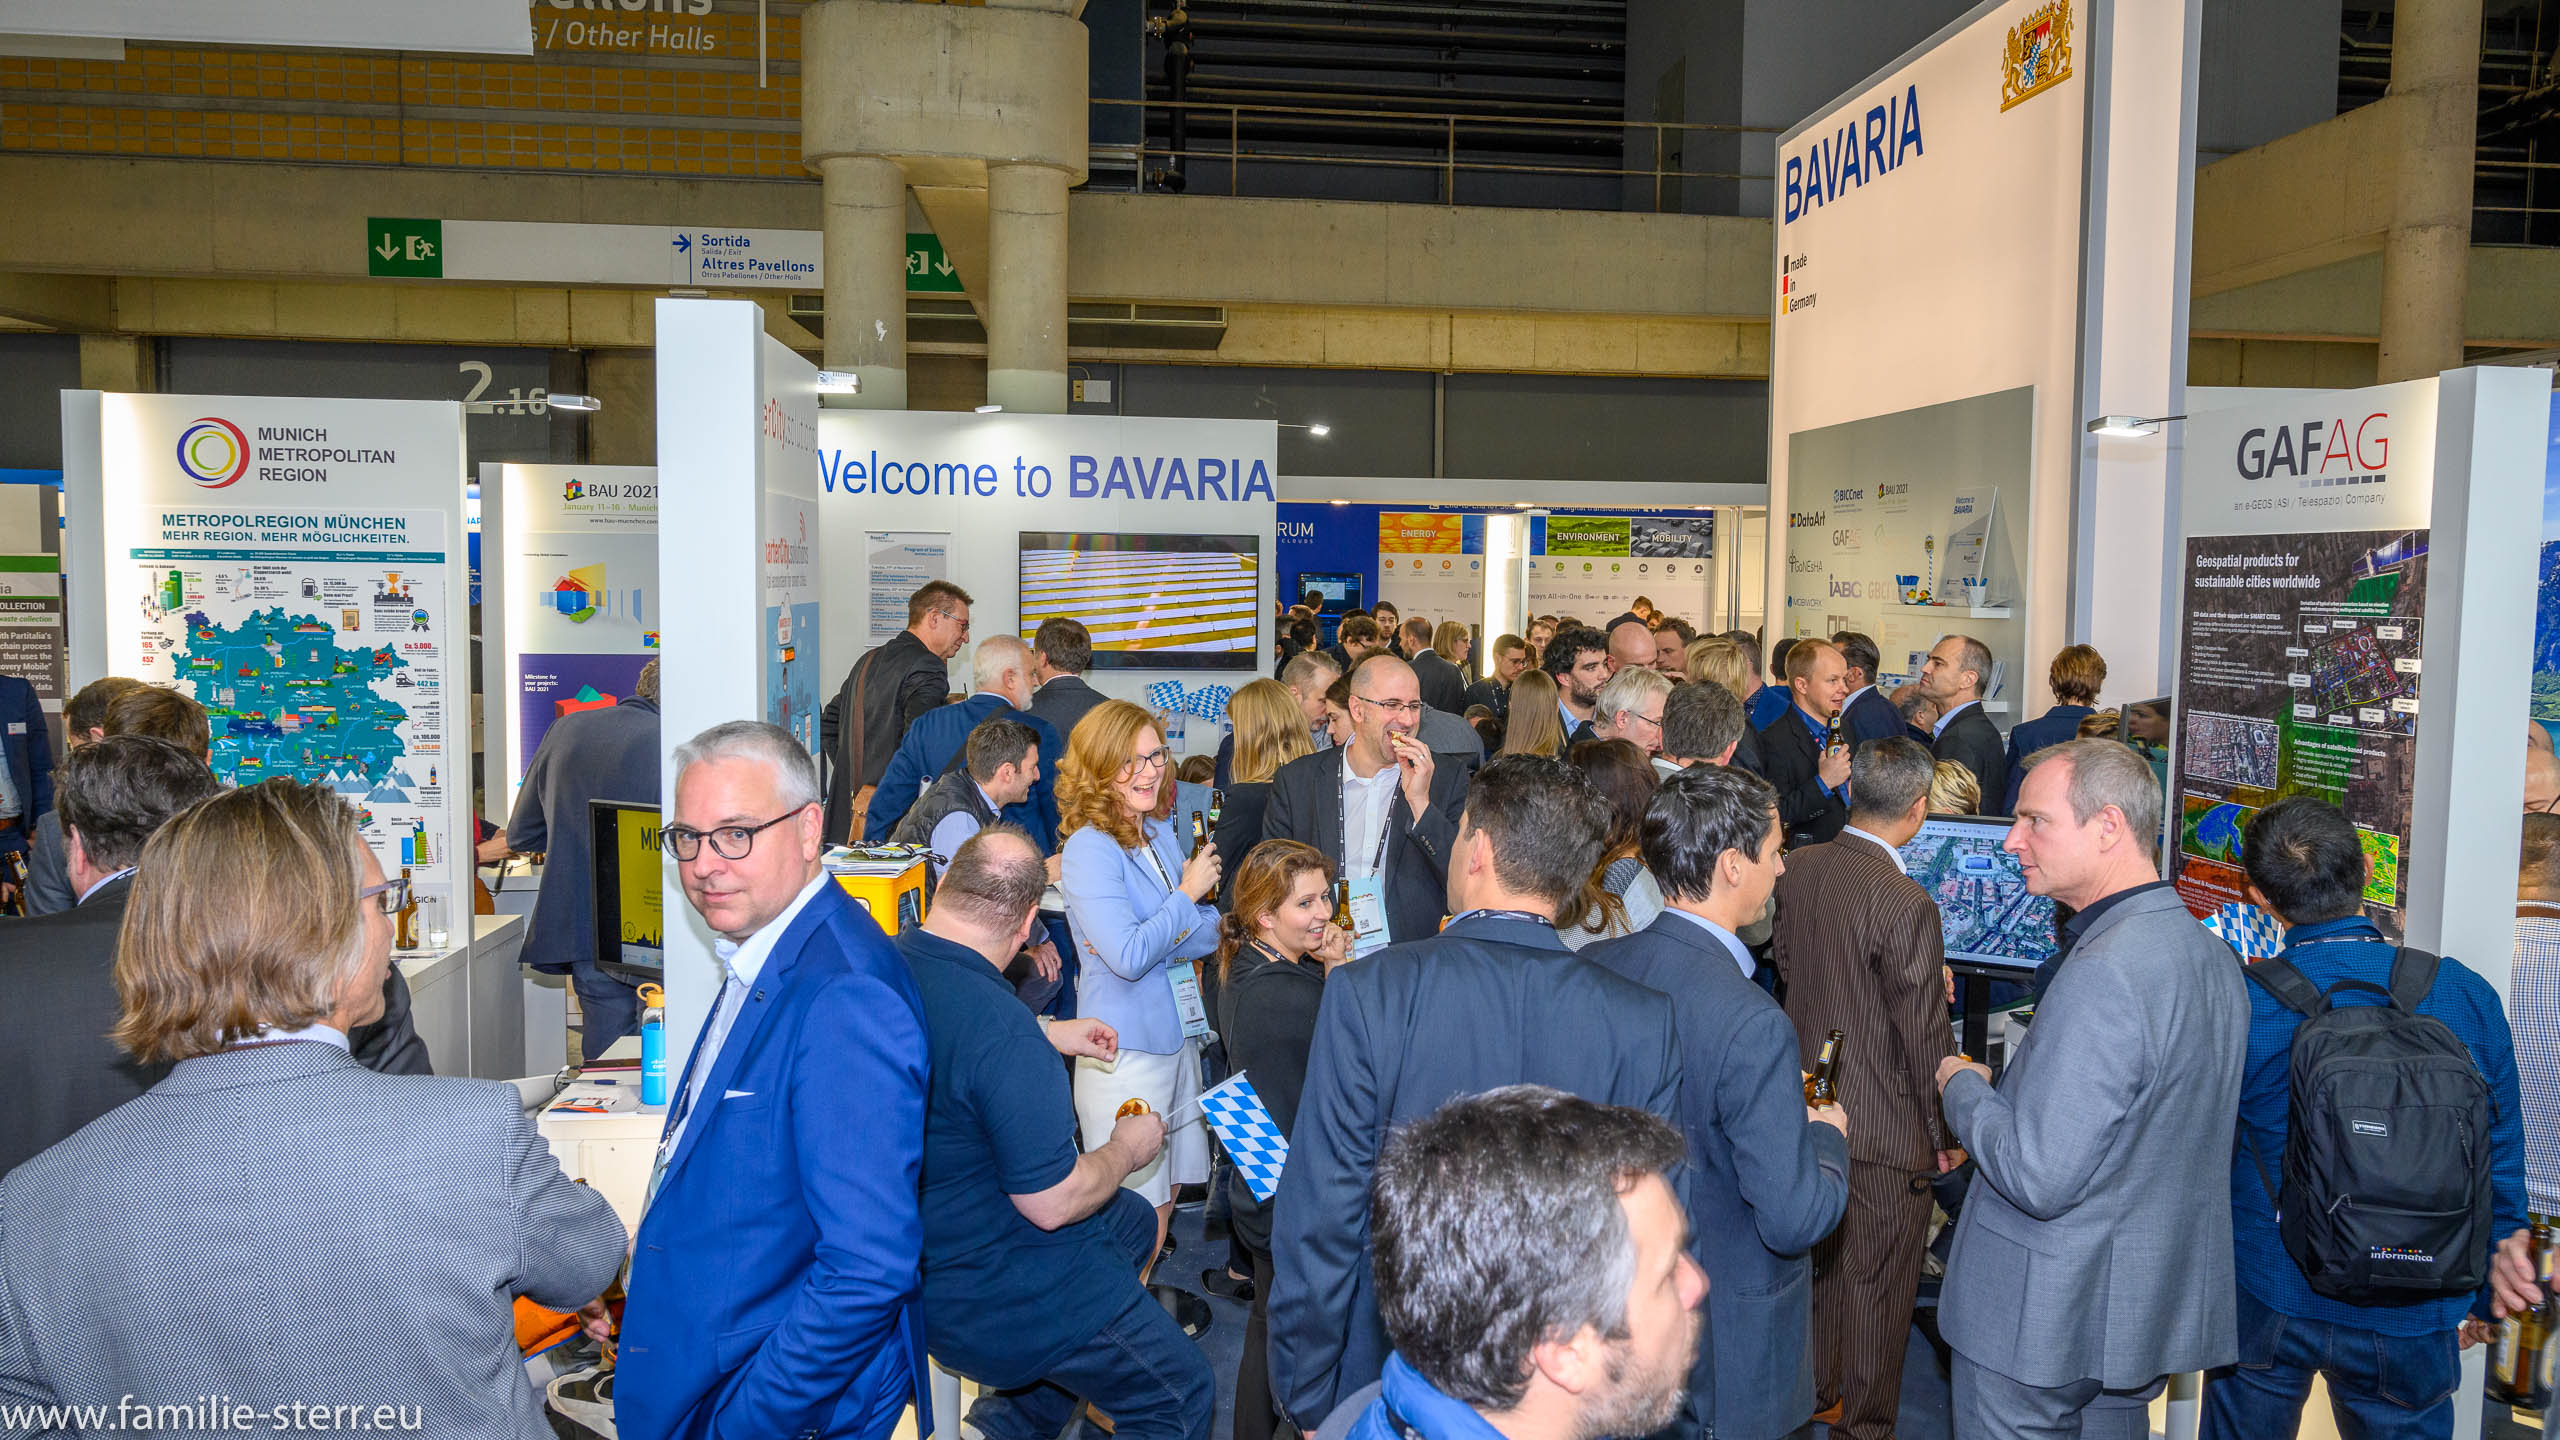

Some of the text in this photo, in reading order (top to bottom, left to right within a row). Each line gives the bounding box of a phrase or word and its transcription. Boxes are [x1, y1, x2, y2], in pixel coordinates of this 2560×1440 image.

[566, 21, 643, 48] Other
[649, 24, 716, 51] Halls
[1785, 84, 1924, 226] BAVARIA
[701, 234, 751, 248] Sortida
[702, 257, 815, 273] Altres Pavellons
[1790, 252, 1808, 272] made
[701, 271, 721, 279] Otros
[721, 271, 758, 280] Pabellones
[784, 273, 801, 281] Halls
[1789, 278, 1796, 293] in
[1789, 291, 1817, 313] Germany
[459, 360, 548, 416] 2.16
[257, 426, 328, 443] MUNICH
[258, 447, 395, 464] METROPOLITAN
[258, 467, 328, 483] REGION
[1013, 455, 1052, 498] to
[1069, 454, 1276, 503] BAVARIA
[588, 483, 659, 500] BAU 2021
[1839, 488, 1864, 501] BICCnet
[1895, 483, 1908, 495] 2021
[2345, 492, 2386, 506] Company
[563, 502, 594, 513] January
[161, 513, 406, 530] METROPOLREGION MÜNCHEN
[1797, 510, 1826, 528] DataArt
[161, 529, 411, 545] MEHR REGION. MEHR MÖGLICHKEITEN.
[1400, 528, 1437, 539] ENERGY
[1556, 532, 1621, 543] ENVIRONMENT
[1652, 533, 1693, 544] MOBILITY
[2195, 552, 2300, 570] Geospatial products for
[2194, 574, 2321, 590] sustainable cities worldwide
[1457, 591, 1470, 599] Our
[1547, 592, 1582, 600] All-in-One
[18, 615, 53, 624] collection
[22, 643, 52, 653] process
[141, 641, 153, 650] 165
[2, 652, 53, 661] that uses the
[141, 655, 155, 664] 452
[25, 672, 53, 682] device,
[416, 680, 429, 688] 442
[524, 673, 558, 681] Milestone for
[35, 682, 54, 691] data
[2370, 1249, 2434, 1263] informatica
